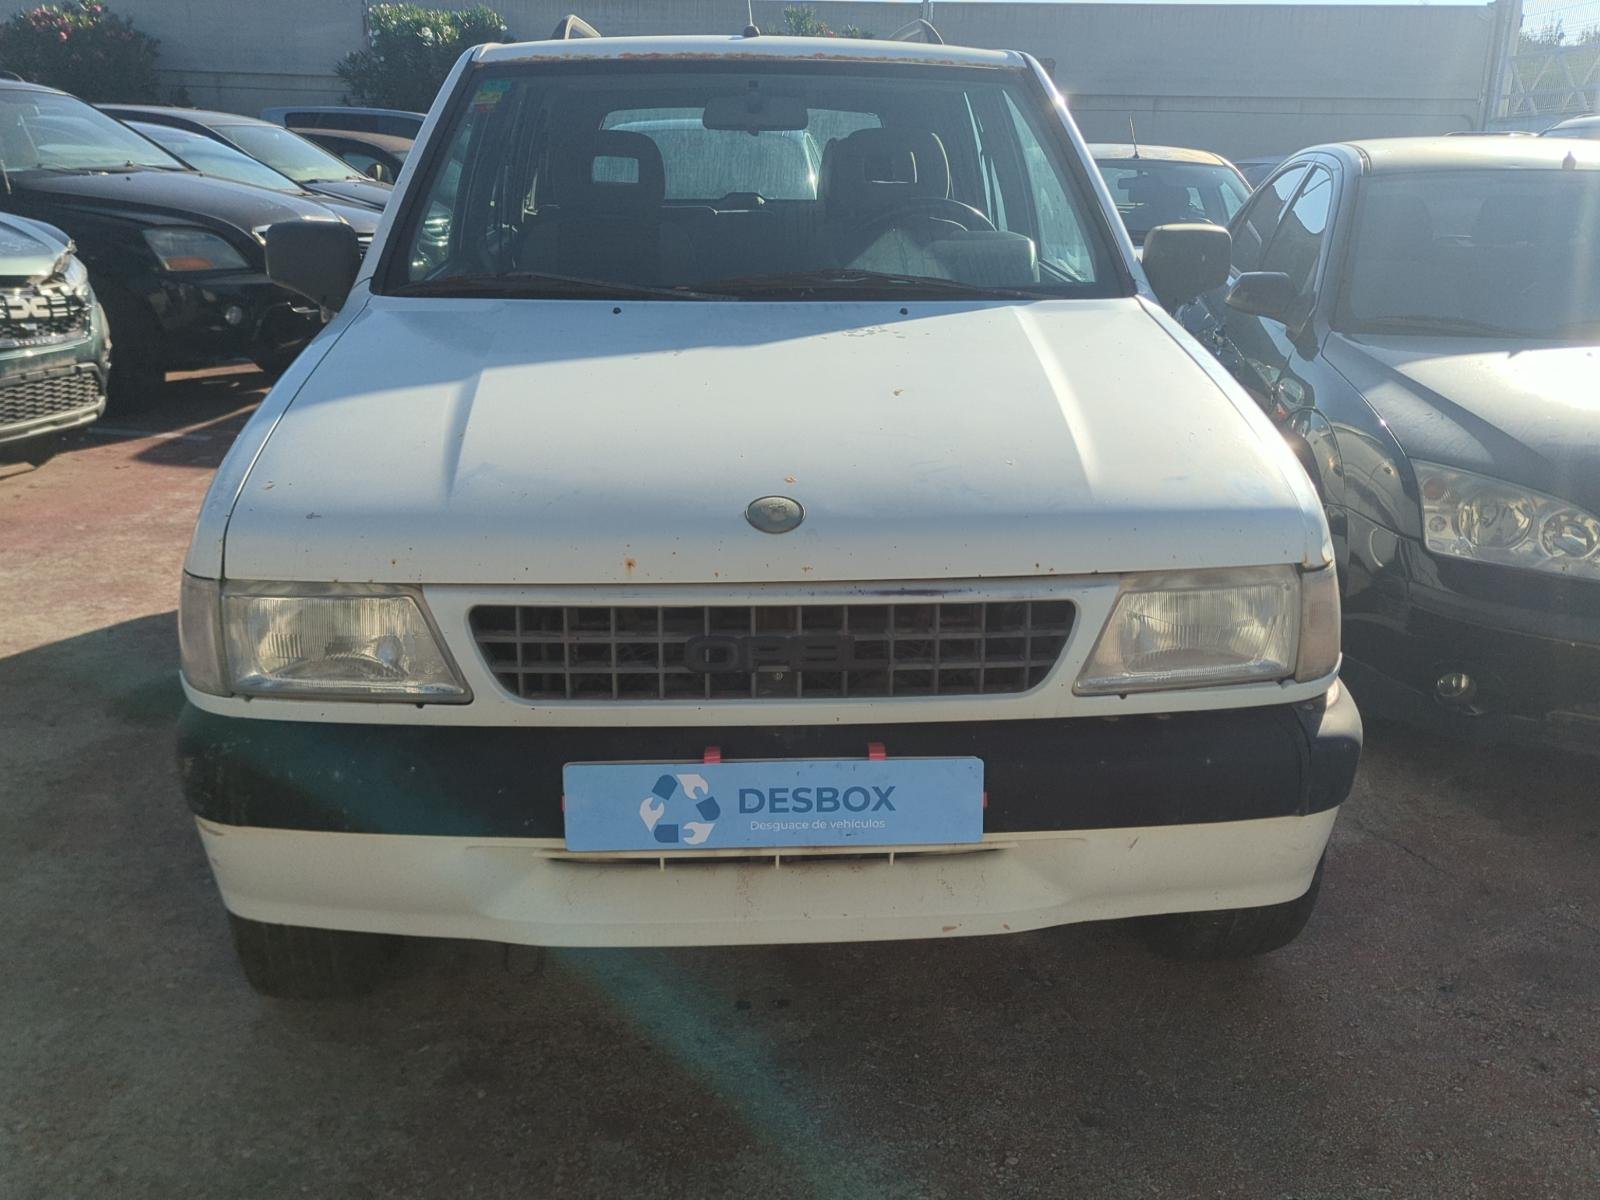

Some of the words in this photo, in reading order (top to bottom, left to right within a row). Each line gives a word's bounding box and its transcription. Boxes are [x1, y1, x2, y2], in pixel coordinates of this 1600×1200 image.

[684, 634, 890, 673] OPEL
[738, 786, 896, 814] DESBOX
[750, 820, 809, 832] Desguace
[811, 819, 827, 830] de
[830, 818, 886, 830] vehículos
